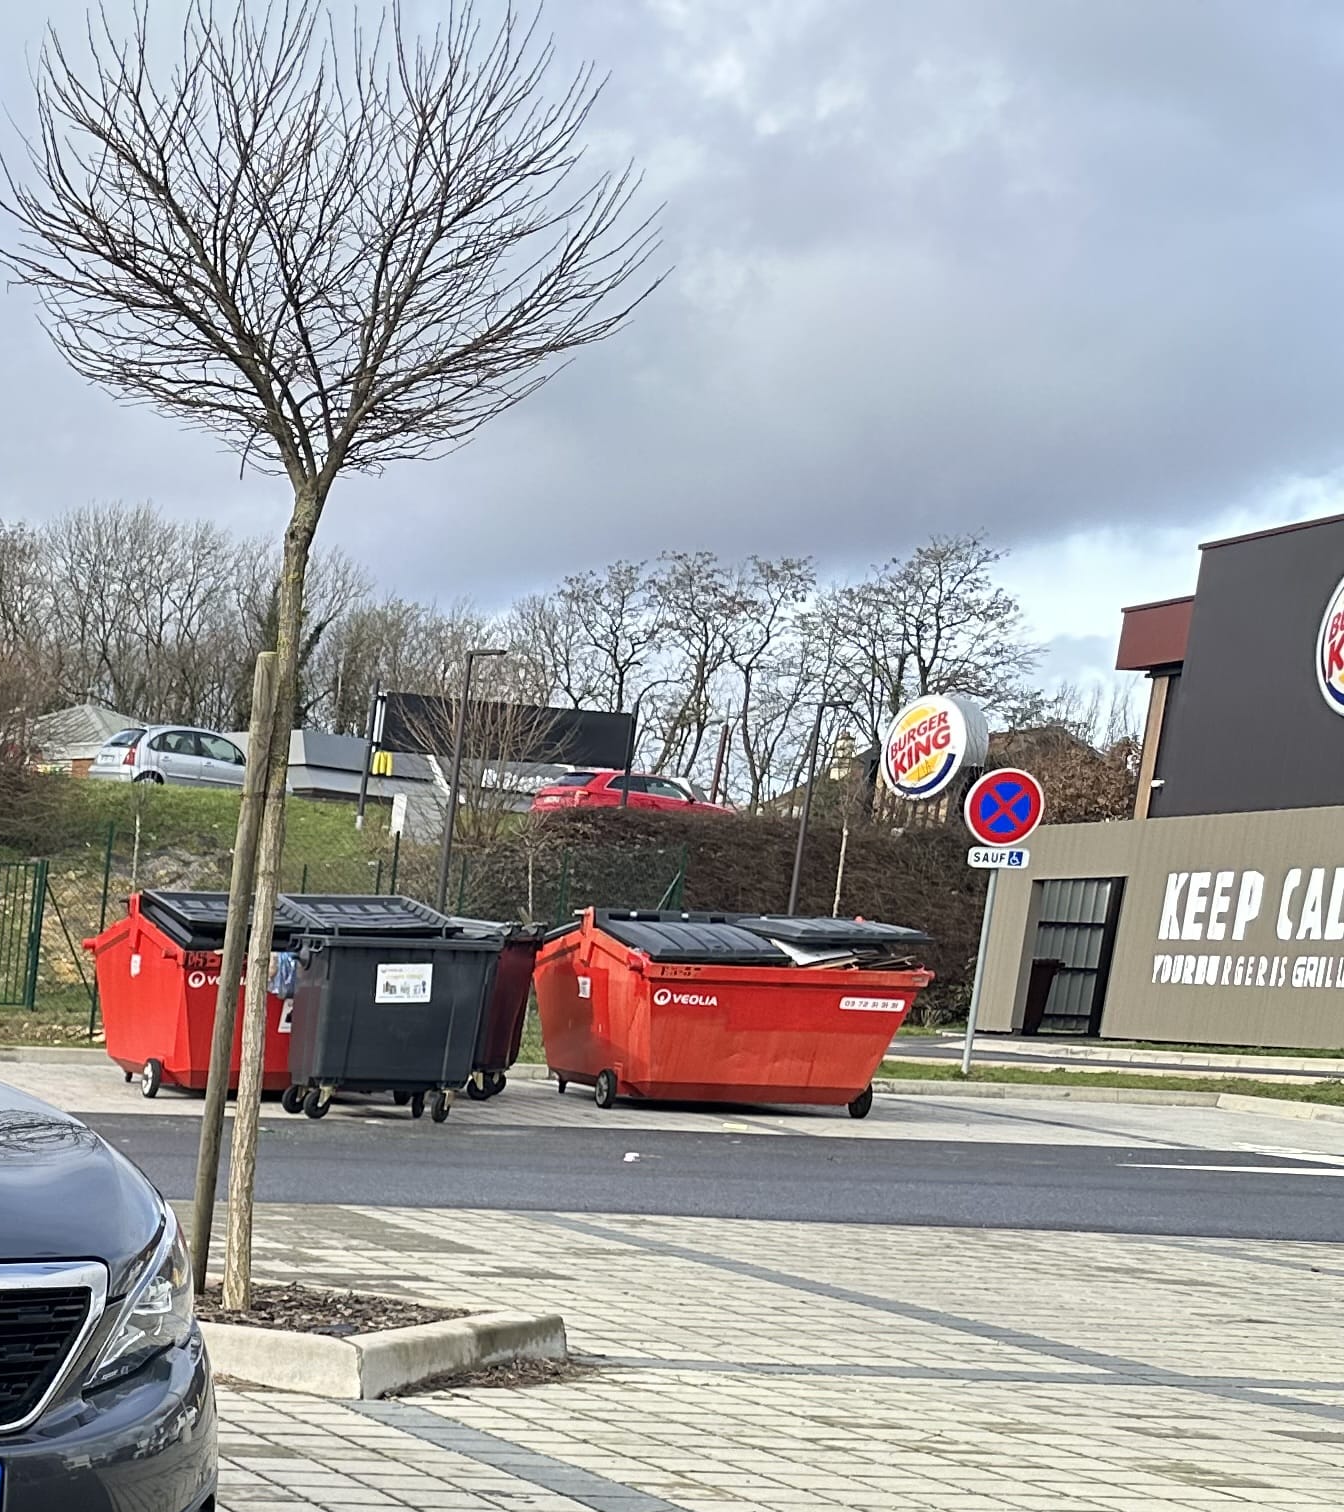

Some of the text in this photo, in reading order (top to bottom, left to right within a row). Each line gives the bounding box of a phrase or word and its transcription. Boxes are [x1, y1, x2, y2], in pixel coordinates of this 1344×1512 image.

[891, 711, 948, 760] BURGER
[893, 725, 951, 783] KING
[973, 852, 1006, 863] SAUF
[1158, 871, 1264, 940] KEEP
[673, 993, 718, 1006] VEOLIA
